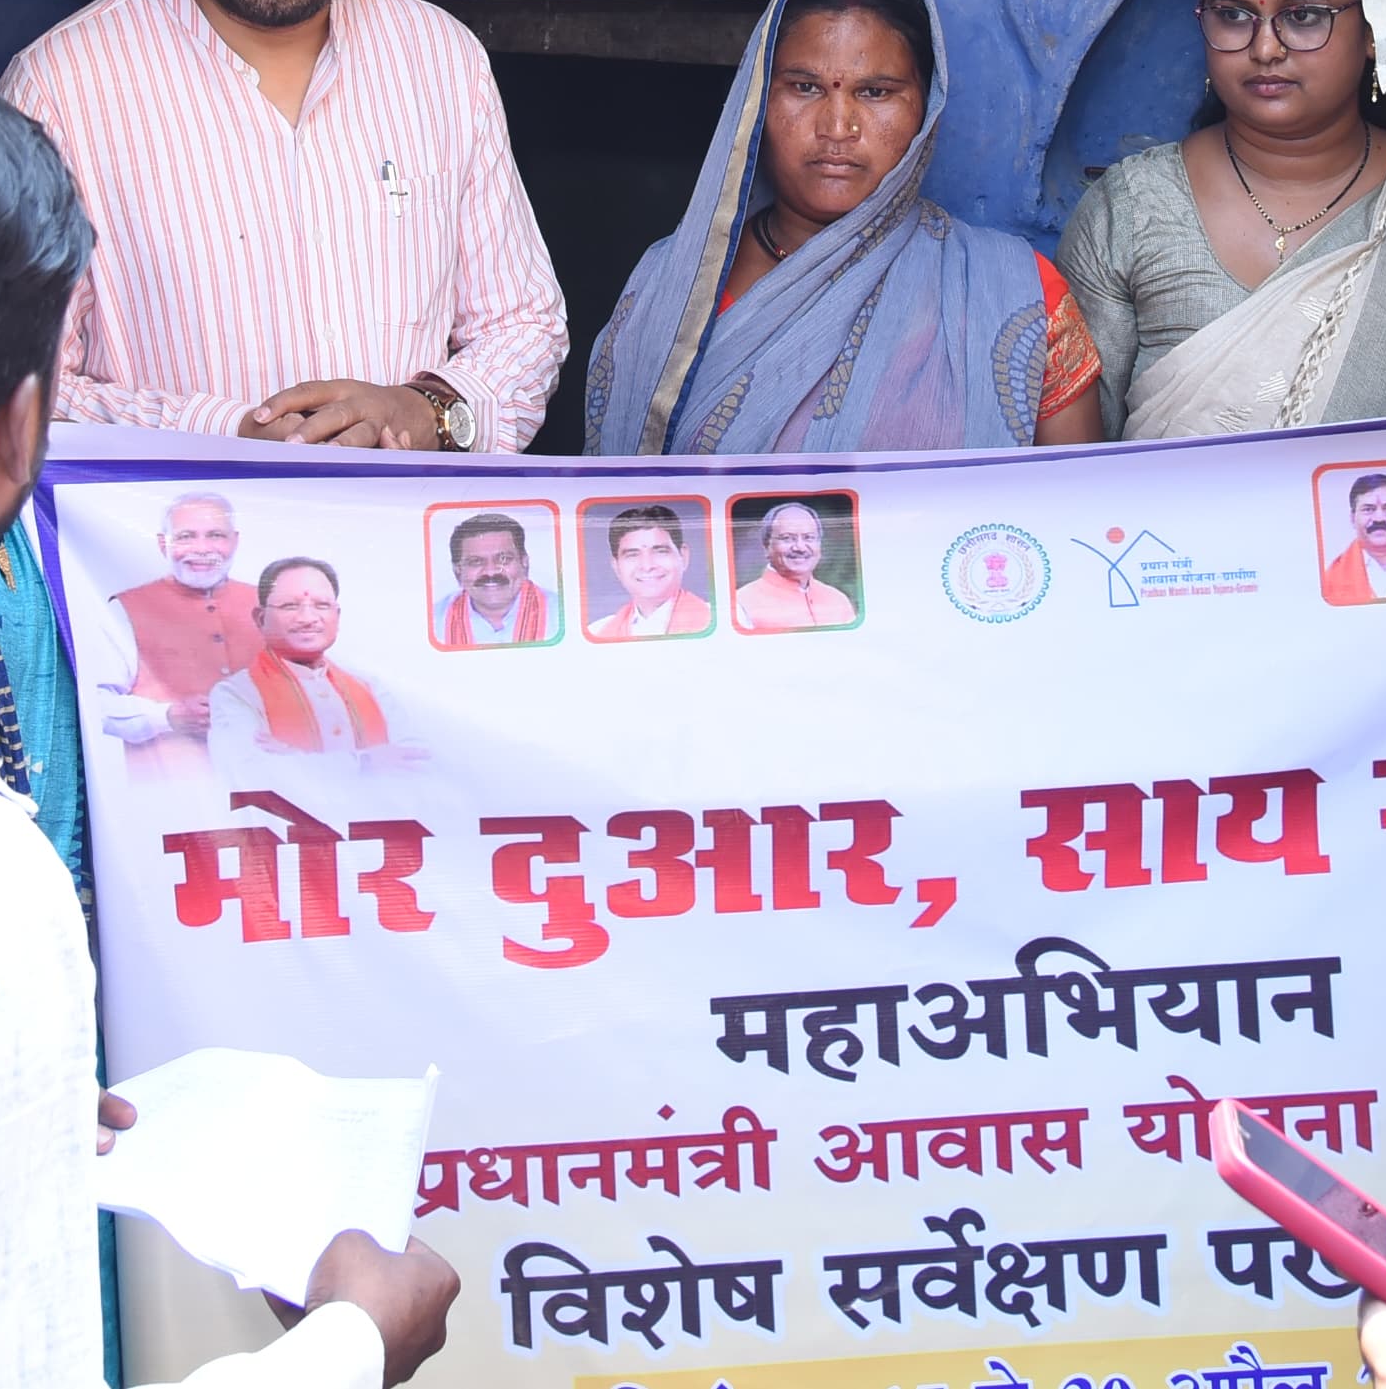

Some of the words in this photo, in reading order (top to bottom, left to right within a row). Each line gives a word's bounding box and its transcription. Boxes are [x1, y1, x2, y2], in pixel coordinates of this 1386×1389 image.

[163, 790, 436, 943] मोर
[479, 799, 957, 969] दुआर,
[1020, 768, 1332, 892] साय
[710, 936, 1342, 1082] महाअभियान
[414, 1105, 778, 1217] प्रधानमंत्री
[814, 1107, 1089, 1183] आवास
[500, 1235, 783, 1350] विशेष
[824, 1207, 1167, 1328] सर्वेक्षण
